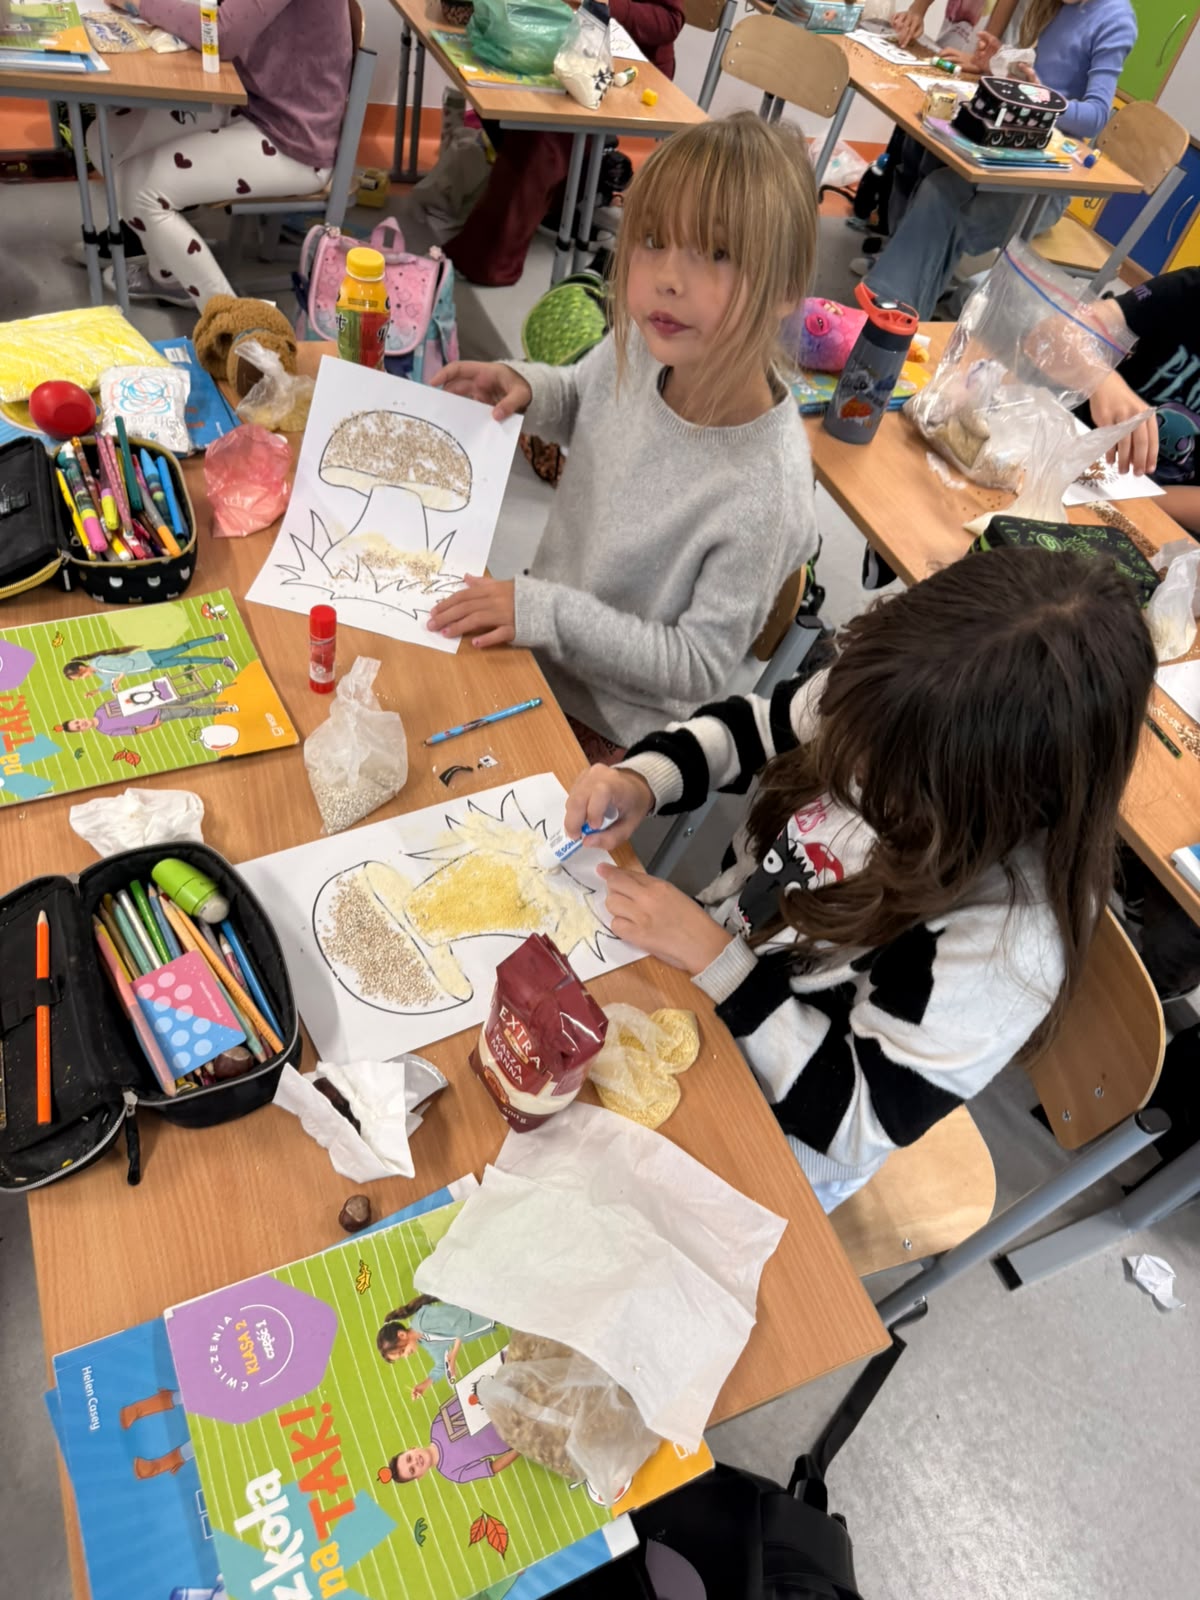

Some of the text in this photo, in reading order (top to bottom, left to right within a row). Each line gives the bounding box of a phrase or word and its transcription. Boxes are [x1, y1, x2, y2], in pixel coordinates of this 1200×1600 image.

[490, 1038, 523, 1085] MANNA
[495, 1034, 523, 1075] KASZA
[499, 1005, 541, 1070] EXTRA
[234, 1319, 261, 1375] KLASA 2
[81, 1365, 101, 1432] Helen Casey
[278, 1402, 357, 1600] na TAK!
